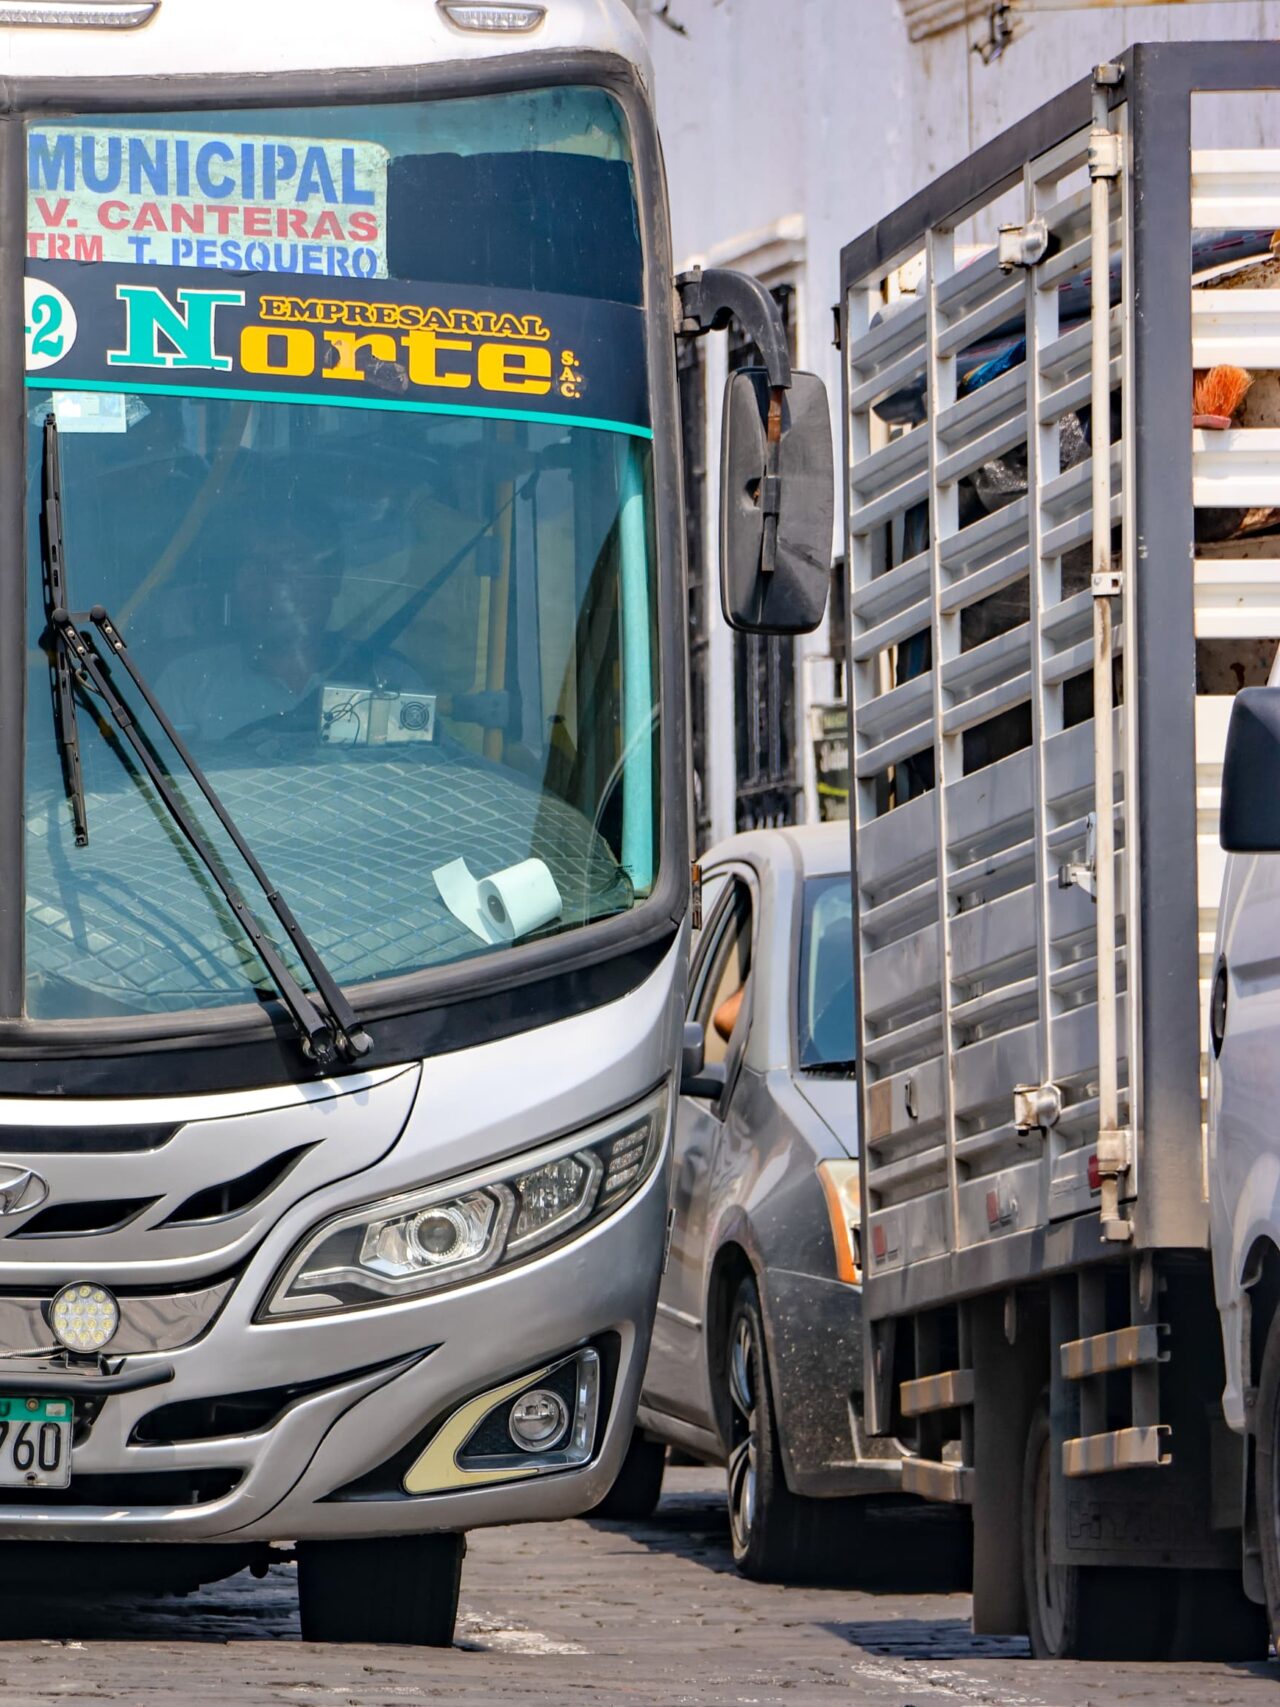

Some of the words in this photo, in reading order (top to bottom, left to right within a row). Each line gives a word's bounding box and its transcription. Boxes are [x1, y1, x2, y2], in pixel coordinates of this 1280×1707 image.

[28, 133, 376, 206] MUNICIPAL
[35, 197, 78, 228] V.
[97, 200, 379, 242] CANTERAS
[128, 237, 157, 264] T.
[172, 239, 378, 279] PESQUERO
[107, 284, 552, 395] Norte
[260, 295, 550, 341] EMPRESARIAL
